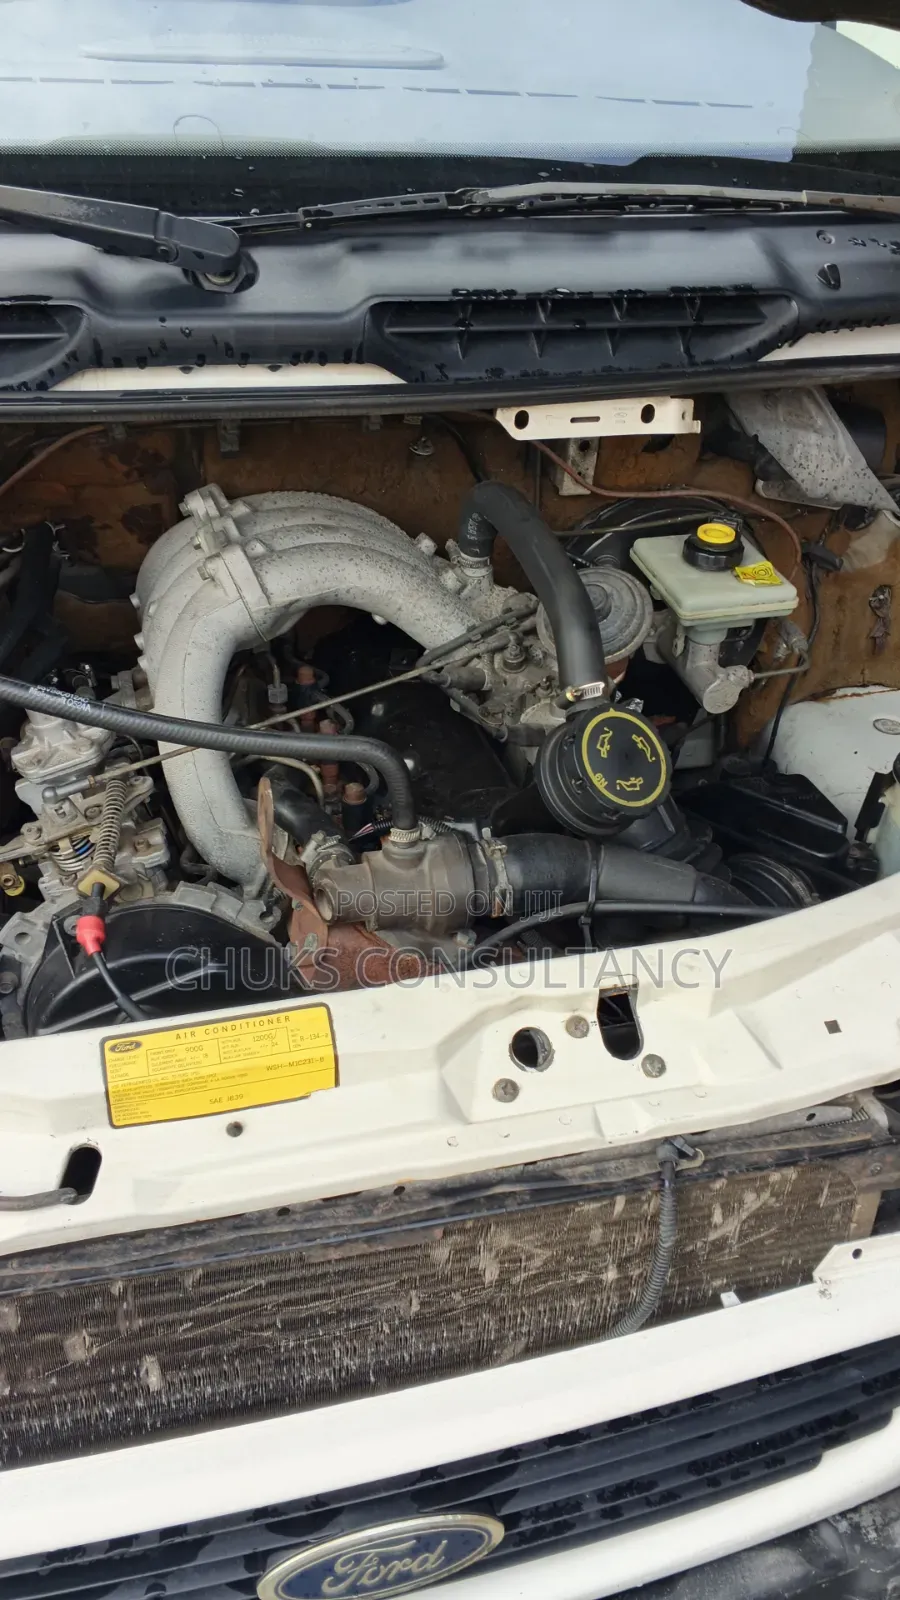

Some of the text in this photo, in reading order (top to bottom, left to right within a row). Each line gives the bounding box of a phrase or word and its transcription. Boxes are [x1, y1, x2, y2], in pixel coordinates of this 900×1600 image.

[176, 1015, 291, 1040] AIR CONDITIONER
[321, 1539, 449, 1594] Ford
